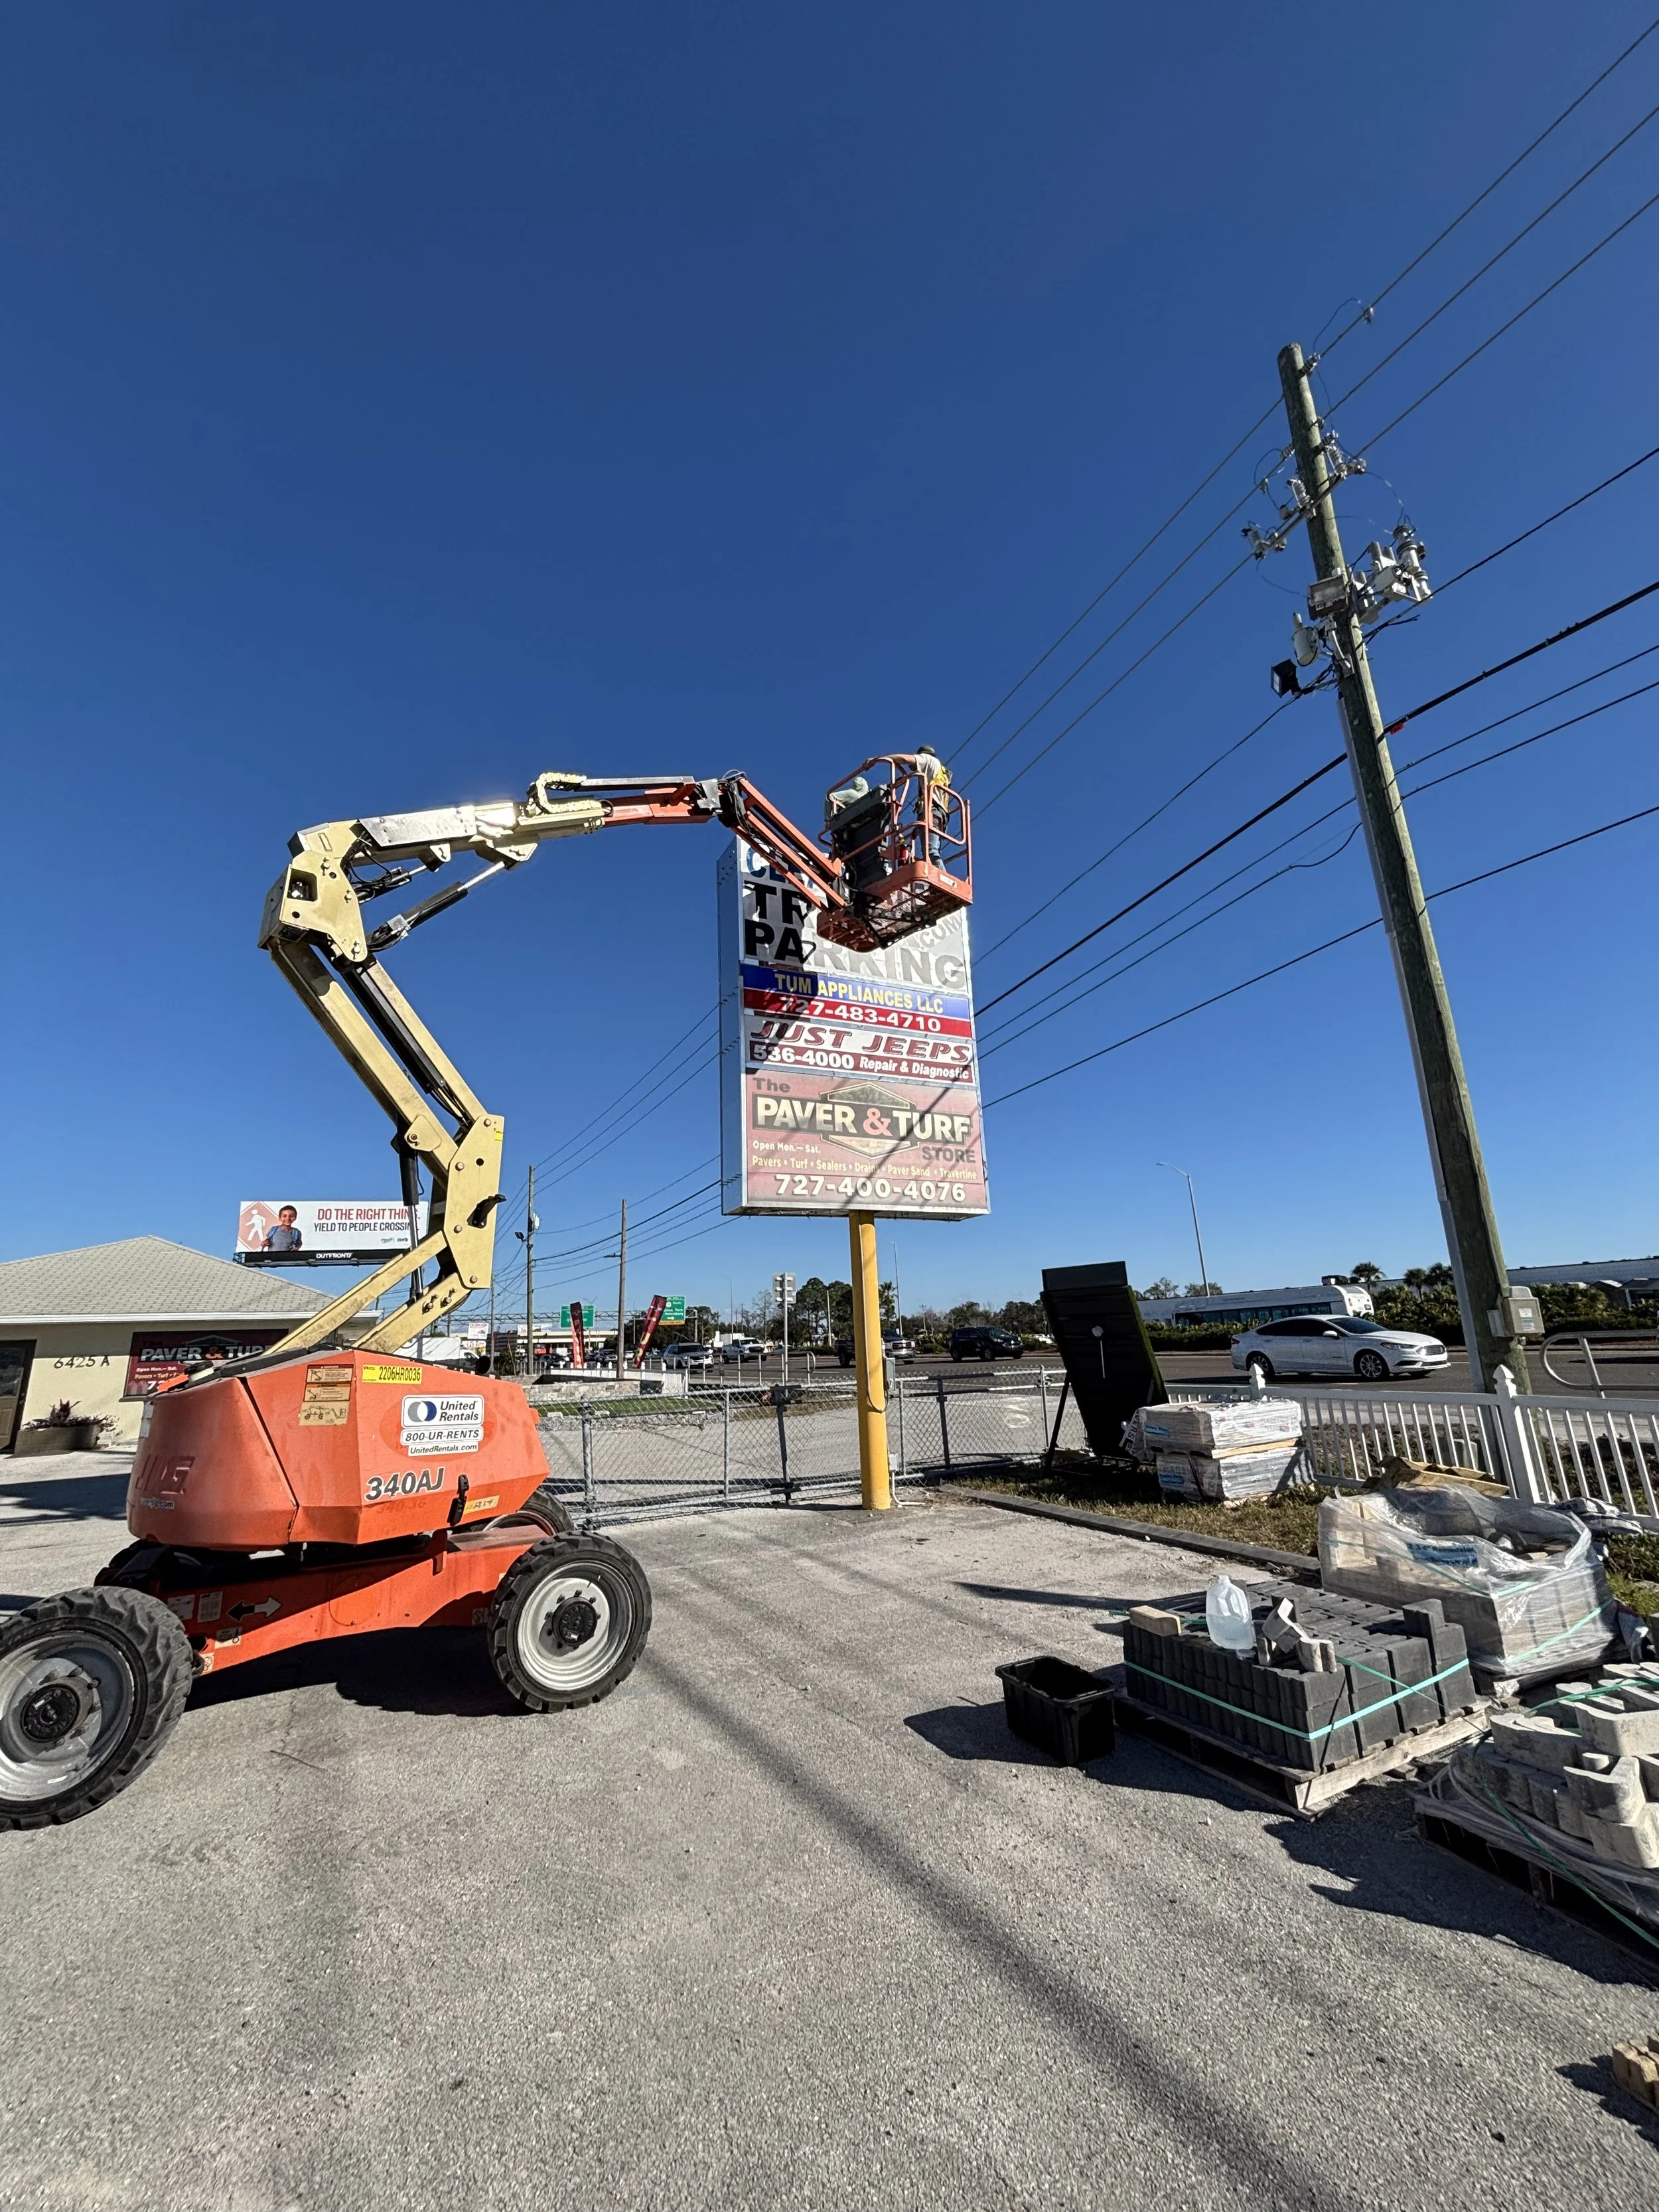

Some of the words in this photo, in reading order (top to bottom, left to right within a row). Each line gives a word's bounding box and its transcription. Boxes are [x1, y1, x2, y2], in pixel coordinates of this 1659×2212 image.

[744, 919, 966, 990] PARKING
[774, 973, 812, 994] TUM
[818, 980, 913, 1009] APPLIANCES
[917, 995, 943, 1013] LLC
[779, 995, 942, 1033] 727-483-4710
[750, 1020, 853, 1049] JUST
[861, 1035, 970, 1063] JEEPS
[753, 1044, 855, 1070] 536-4000
[859, 1056, 899, 1072] Repair
[899, 1061, 909, 1073] &
[912, 1062, 970, 1080] Diagnostic
[752, 1077, 791, 1093] The
[757, 1096, 858, 1134] PAVER
[863, 1108, 893, 1137] &
[892, 1110, 971, 1142] TURF
[753, 1140, 775, 1151] Open
[805, 1144, 822, 1154] Sat.
[922, 1146, 976, 1163] STORE
[752, 1155, 782, 1168] Pavers
[789, 1157, 808, 1169] Turf
[816, 1159, 847, 1171] Sealers
[854, 1162, 880, 1174] Drains
[887, 1164, 909, 1175] Paver
[910, 1166, 930, 1177] Sand
[939, 1168, 977, 1179] Travertine
[774, 1174, 966, 1202] 727-400-4076
[317, 1209, 332, 1220] DO
[334, 1209, 354, 1220] THE
[356, 1209, 387, 1220] RIGHT
[313, 1222, 336, 1232] YIELD
[338, 1222, 348, 1232] TO
[348, 1222, 378, 1232] PEOPLE
[140, 1347, 202, 1361] PAVER
[204, 1347, 224, 1360] &
[226, 1345, 273, 1359] TUR
[53, 1355, 96, 1369] 6425
[100, 1355, 110, 1366] A
[378, 1366, 421, 1382] 2206HR0036
[440, 1400, 476, 1411] United
[439, 1411, 479, 1422] Rentals
[405, 1430, 480, 1442] 800-UR-RENTS
[409, 1444, 478, 1454] UnitedRentals.com
[365, 1467, 445, 1501] 340AJ
